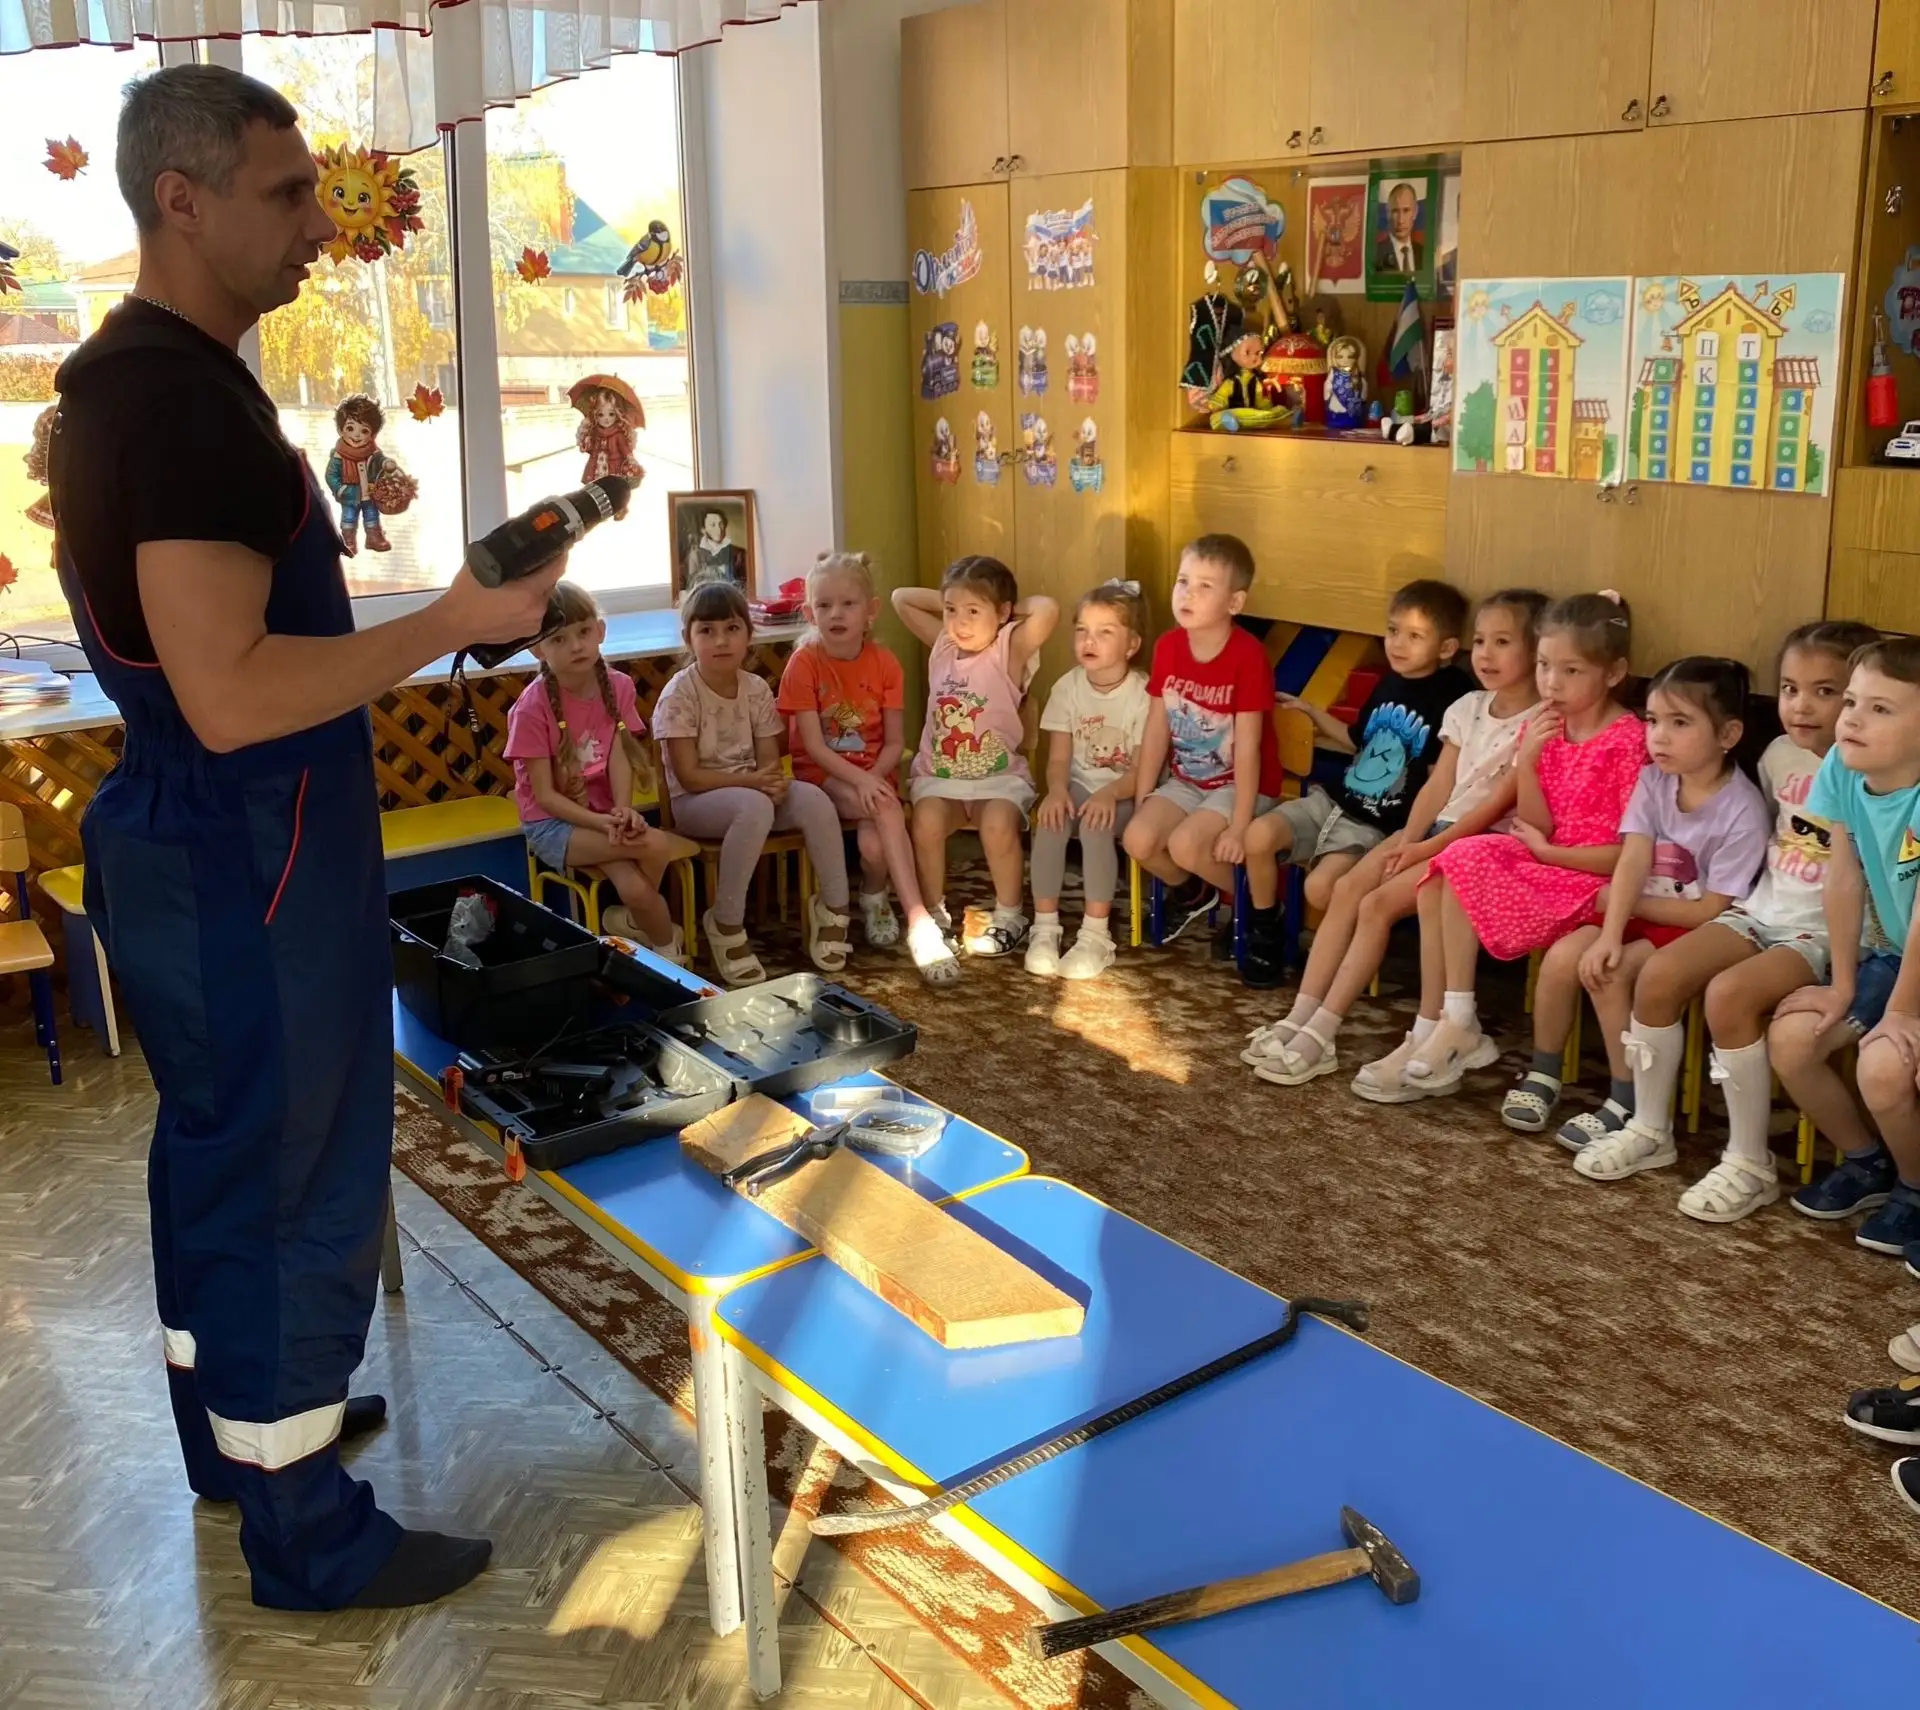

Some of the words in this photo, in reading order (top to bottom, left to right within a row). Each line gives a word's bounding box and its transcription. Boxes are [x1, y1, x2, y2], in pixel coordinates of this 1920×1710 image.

[1701, 339, 1713, 356] П
[1742, 340, 1756, 358] Т
[1700, 367, 1713, 384] К
[1508, 427, 1520, 442] А
